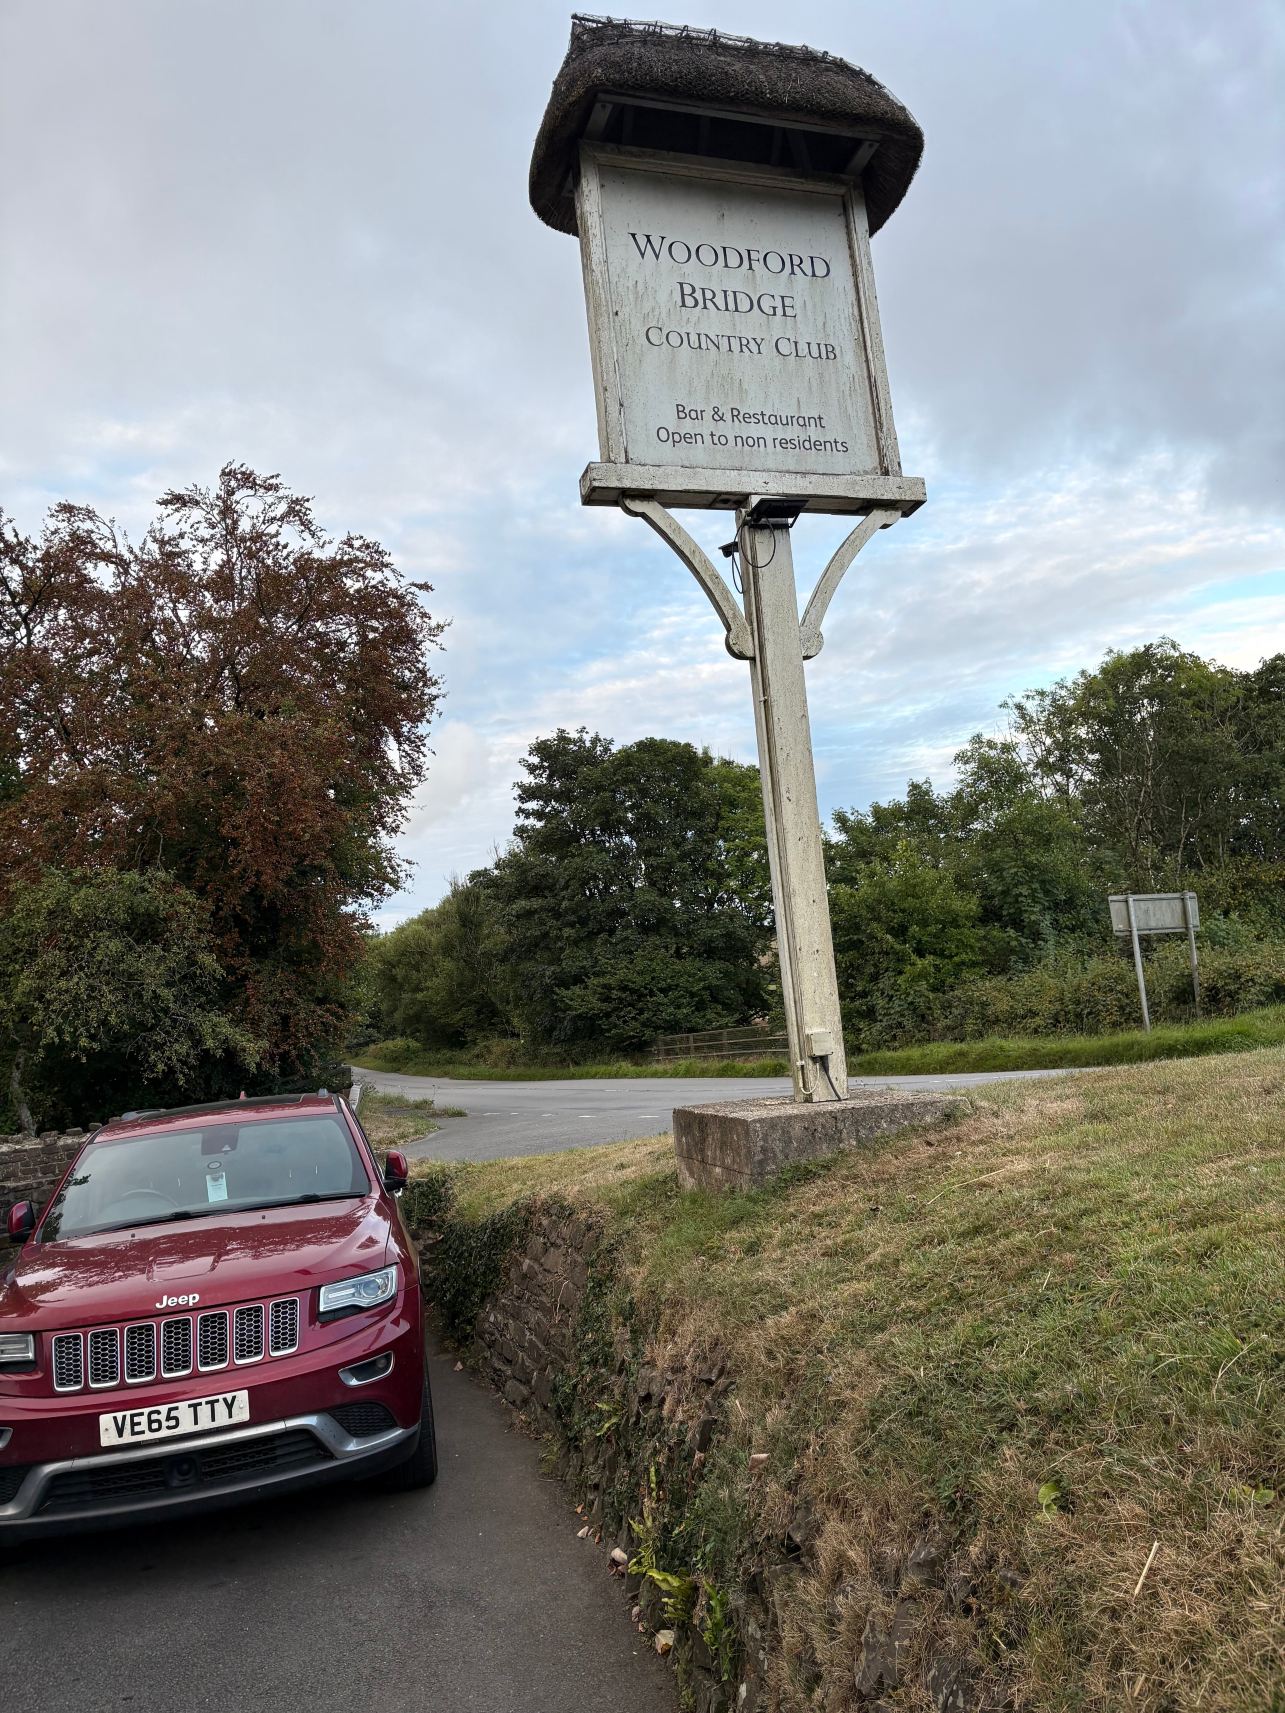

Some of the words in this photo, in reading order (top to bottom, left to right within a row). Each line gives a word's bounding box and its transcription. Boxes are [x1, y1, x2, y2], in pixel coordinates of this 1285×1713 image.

[628, 232, 831, 279] WOODFORD
[676, 281, 797, 318] BRIDGE
[645, 326, 765, 355] COUNTRY
[774, 336, 838, 361] CLUB
[676, 403, 706, 421] Bar
[711, 406, 727, 423] &
[730, 407, 826, 429] Restaurant
[656, 426, 705, 448] Open
[709, 430, 729, 446] to
[734, 434, 767, 449] non
[772, 435, 849, 453] residents
[155, 1293, 200, 1309] Jeep
[112, 1406, 180, 1438] VE65
[187, 1395, 237, 1426] TTY
